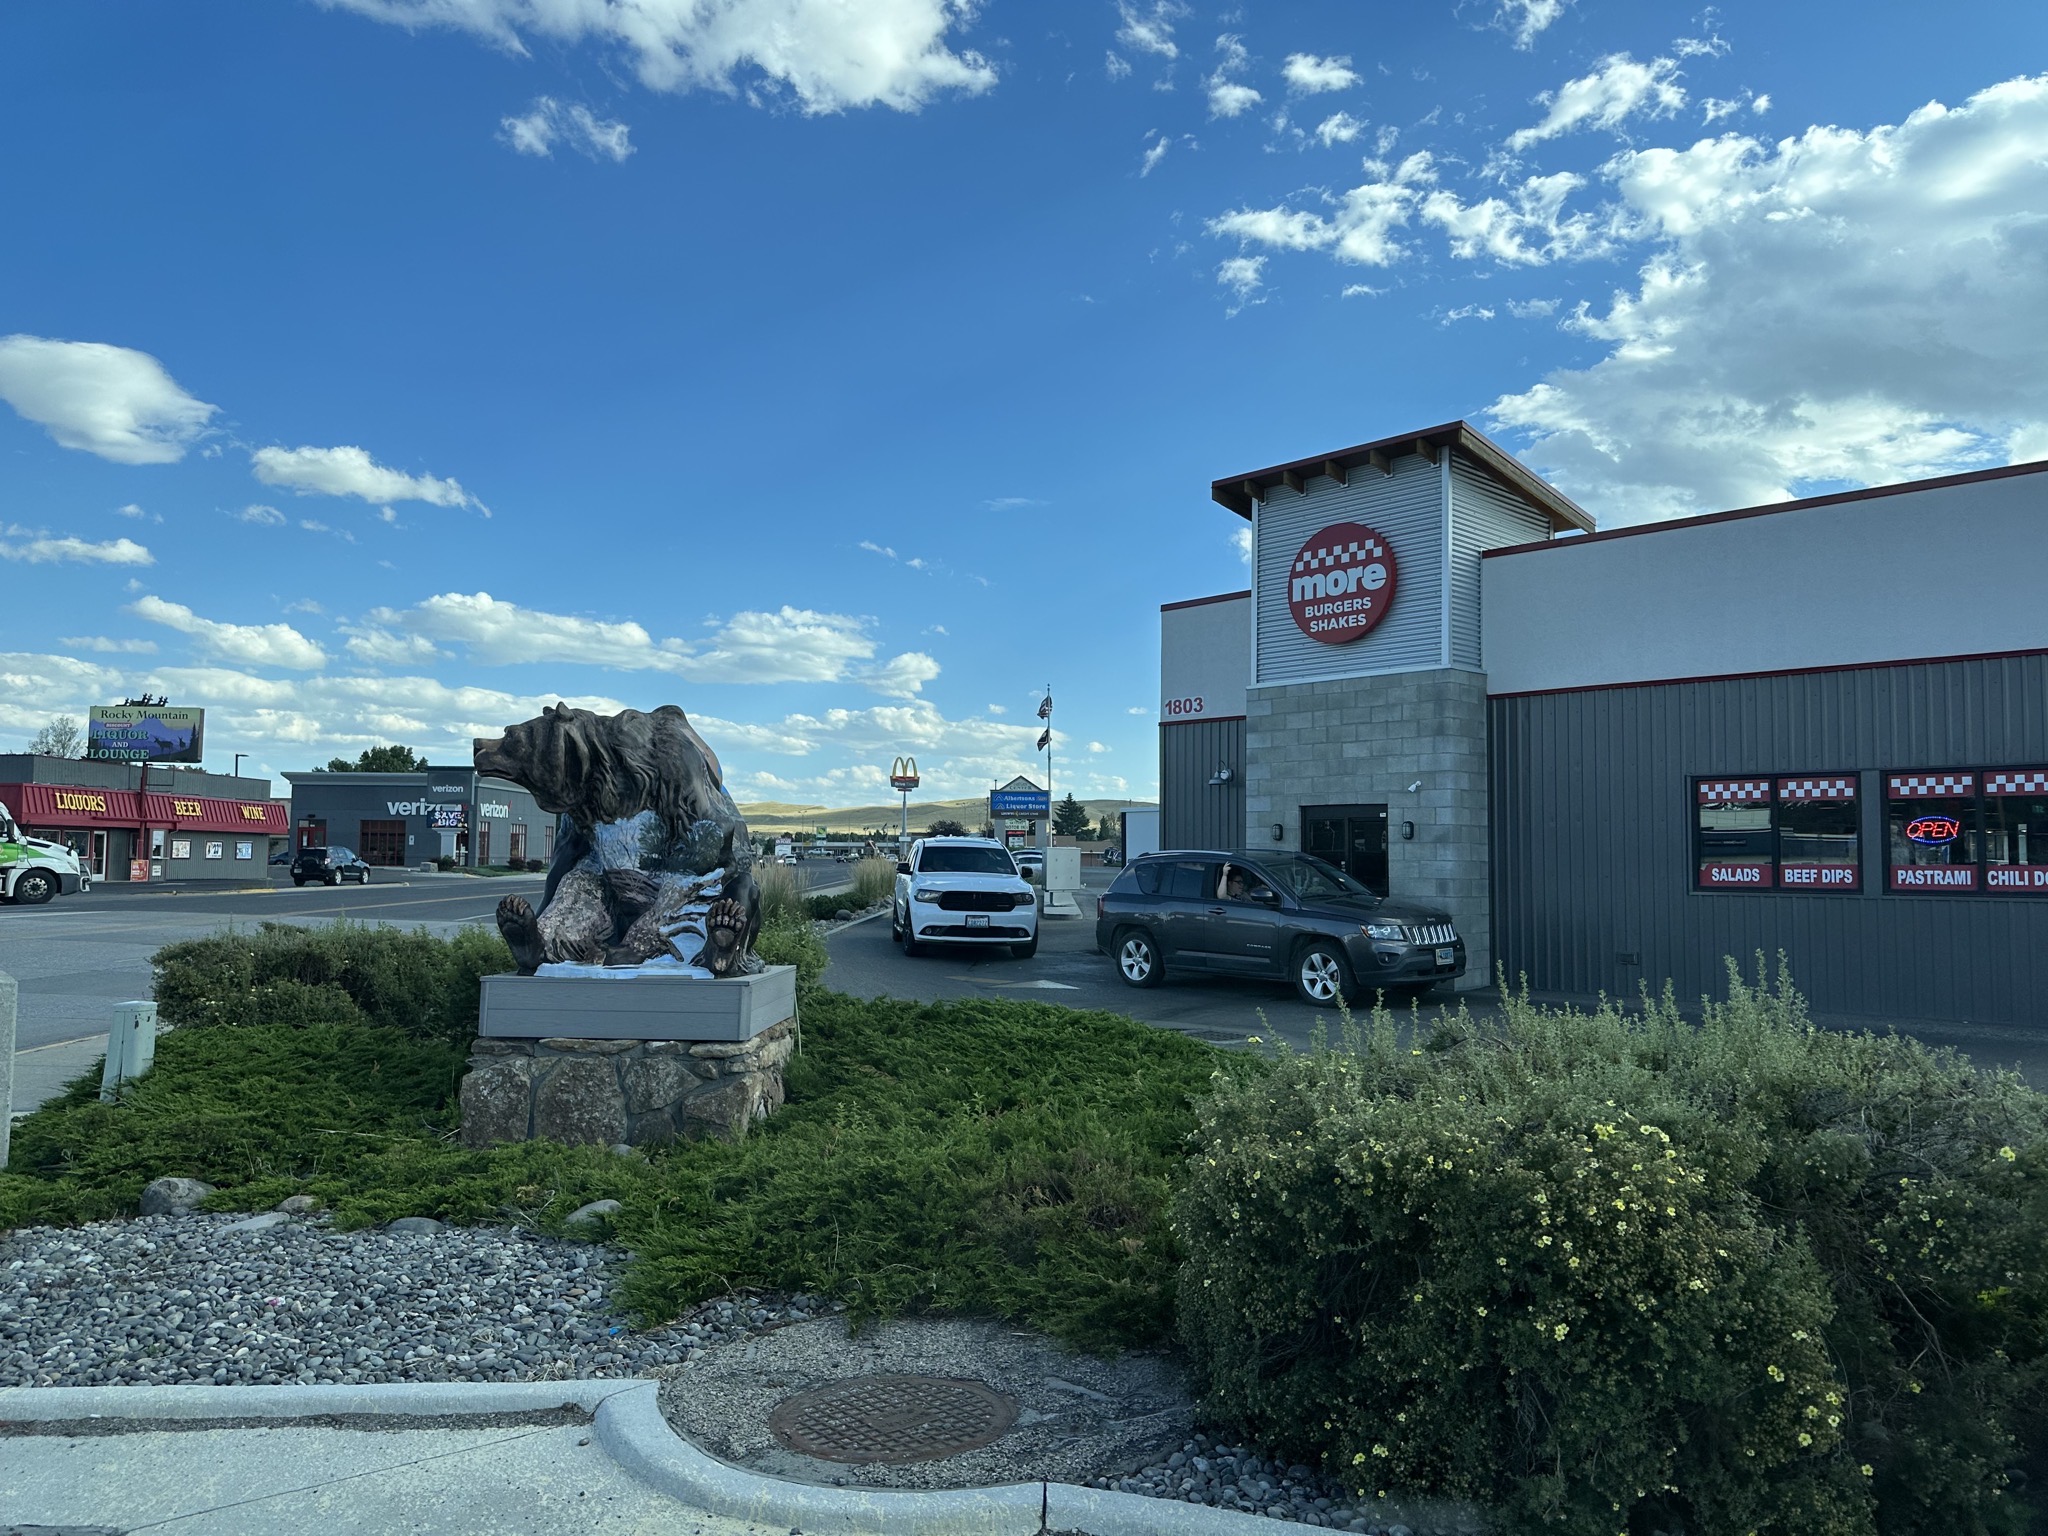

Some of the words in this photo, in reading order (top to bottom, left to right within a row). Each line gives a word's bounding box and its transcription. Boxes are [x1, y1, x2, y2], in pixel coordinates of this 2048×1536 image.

[1292, 563, 1387, 602] more
[1305, 597, 1372, 618] BURGERS
[1309, 613, 1367, 632] SHAKES
[1164, 697, 1204, 715] 1803
[101, 710, 134, 722] Rocky
[136, 710, 189, 720] Mountain
[92, 729, 148, 740] LIQUOR
[89, 748, 150, 759] LOUNGE
[432, 785, 464, 793] verizon
[55, 792, 106, 811] LIQUORS
[173, 801, 203, 816] BEER
[240, 805, 266, 820] WINE
[480, 800, 509, 818] verizon
[1006, 803, 1028, 811] Liquor
[1906, 820, 1960, 838] OPEN
[1711, 867, 1760, 882] SALADS
[1784, 869, 1818, 883] BEEF
[1822, 869, 1853, 884] DIPS
[1897, 869, 1972, 885] PASTRAMI
[1987, 870, 2029, 886] CHILI
